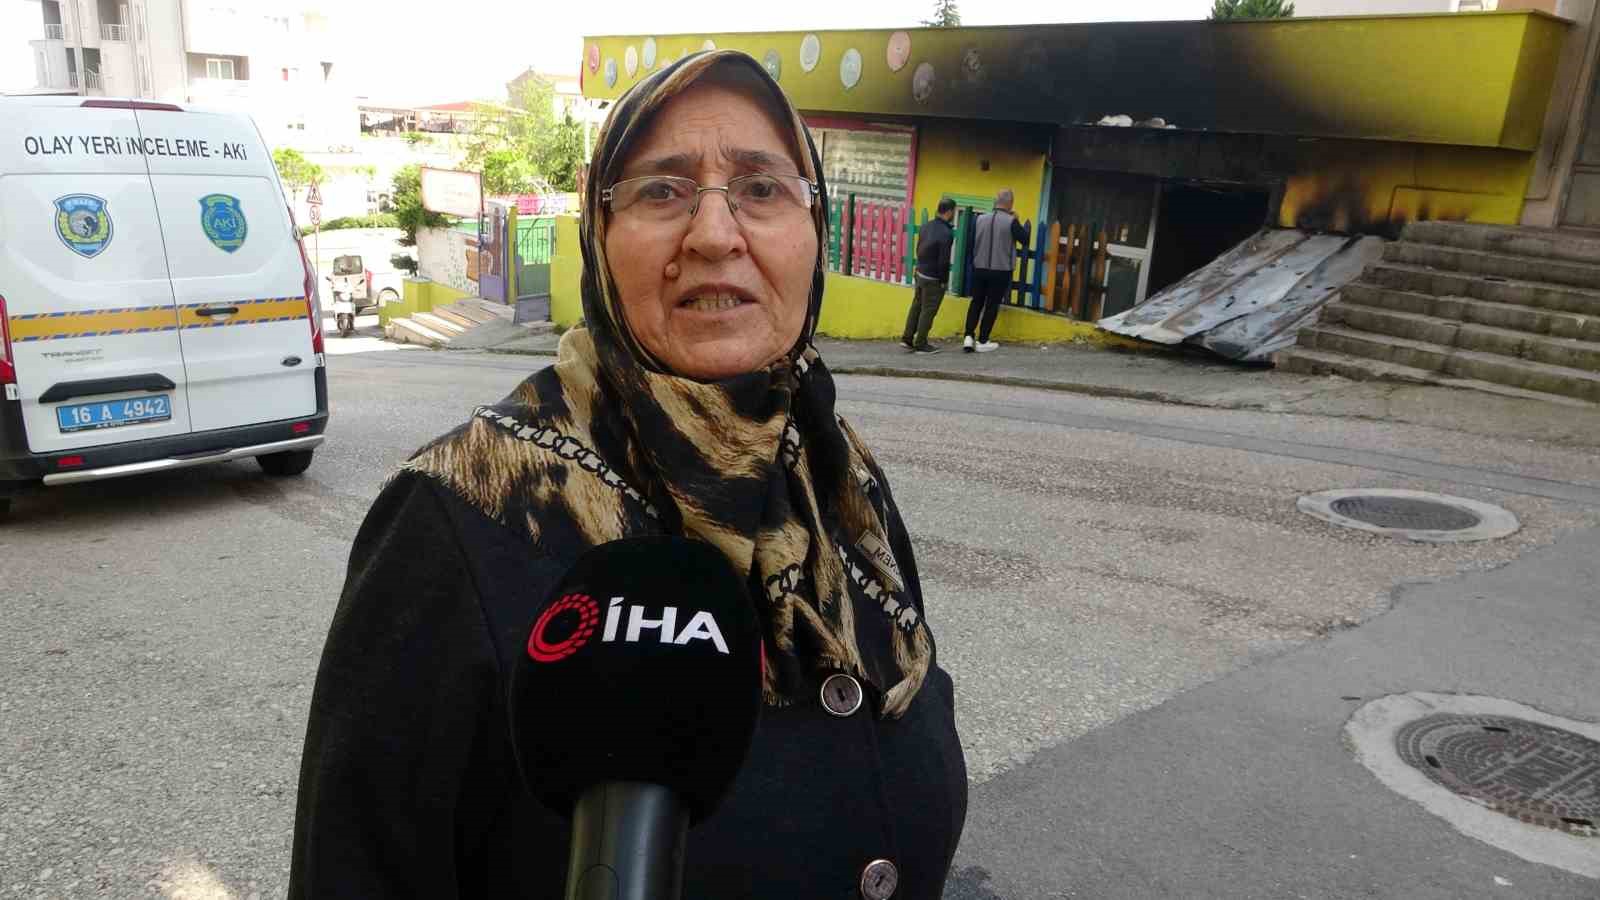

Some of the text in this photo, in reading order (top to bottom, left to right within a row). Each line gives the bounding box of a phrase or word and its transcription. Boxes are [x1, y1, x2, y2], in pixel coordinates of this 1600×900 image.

[24, 135, 73, 155] OLAY
[71, 398, 167, 424] 16 A 4942
